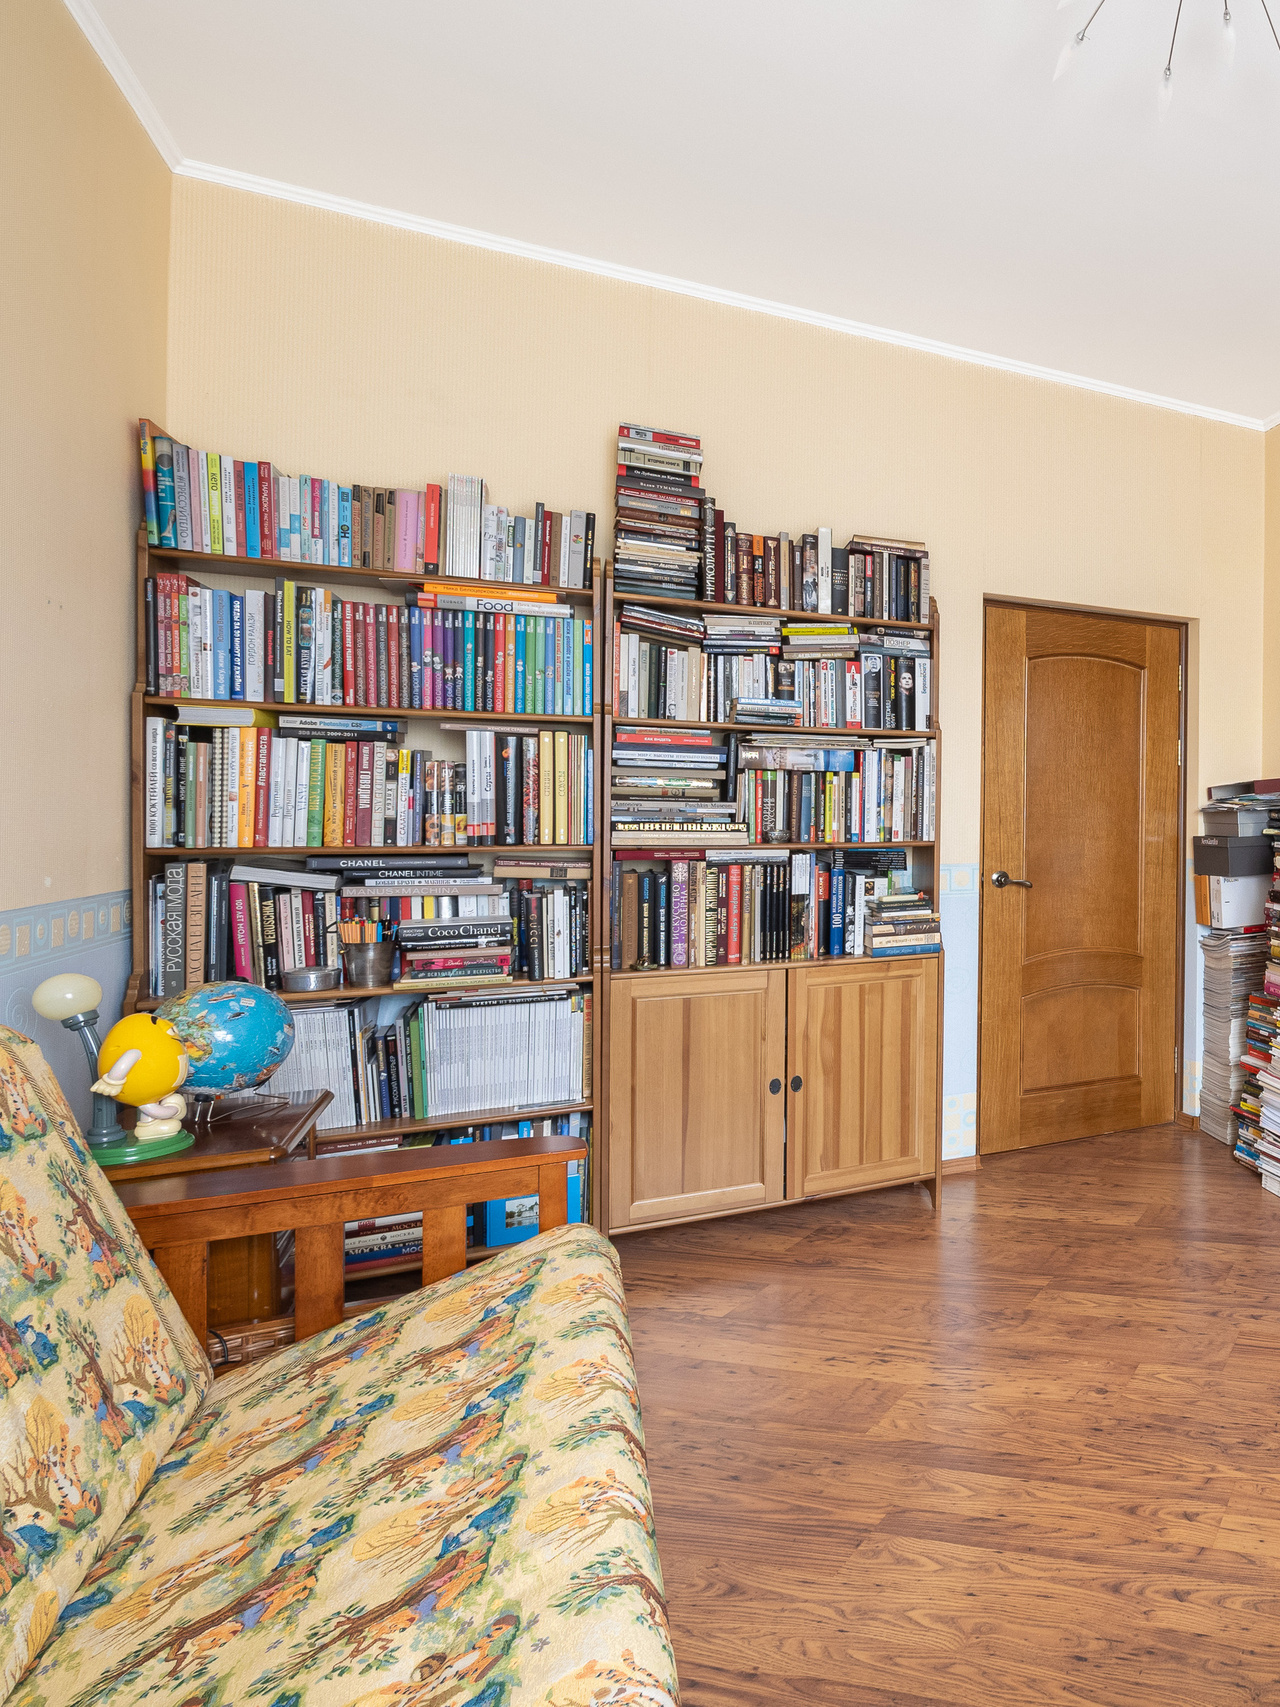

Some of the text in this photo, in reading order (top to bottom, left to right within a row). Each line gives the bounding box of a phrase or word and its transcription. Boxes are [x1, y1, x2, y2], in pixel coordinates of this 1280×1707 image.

[177, 475, 189, 538] #ПРЕССУЙТЕЛО
[706, 534, 715, 543] II
[706, 545, 715, 595] НИКОЛАЙ
[476, 599, 514, 612] Food
[248, 612, 256, 666] ГОРДОН РАМЗИ
[287, 635, 291, 643] TO
[150, 728, 158, 744] мира
[258, 735, 268, 786] #пастапаста
[309, 745, 321, 810] ВКУС ТОСКАНЫ
[150, 772, 158, 817] КОКТЕЙЛЕЙ
[359, 770, 371, 809] ГОВЯДИНА
[150, 818, 158, 836] 1000
[378, 870, 415, 878] CHANEL
[264, 900, 276, 944] VERUSCHKA
[428, 924, 501, 937] Coco Chanel
[672, 884, 680, 939] ИСКУССТВО
[680, 889, 688, 936] МОДЕРНА
[705, 867, 718, 965] СОВРЕМЕННАЯ ЖИВОПИСЬ
[832, 914, 843, 929] 100
[238, 924, 246, 945] МОДЫ
